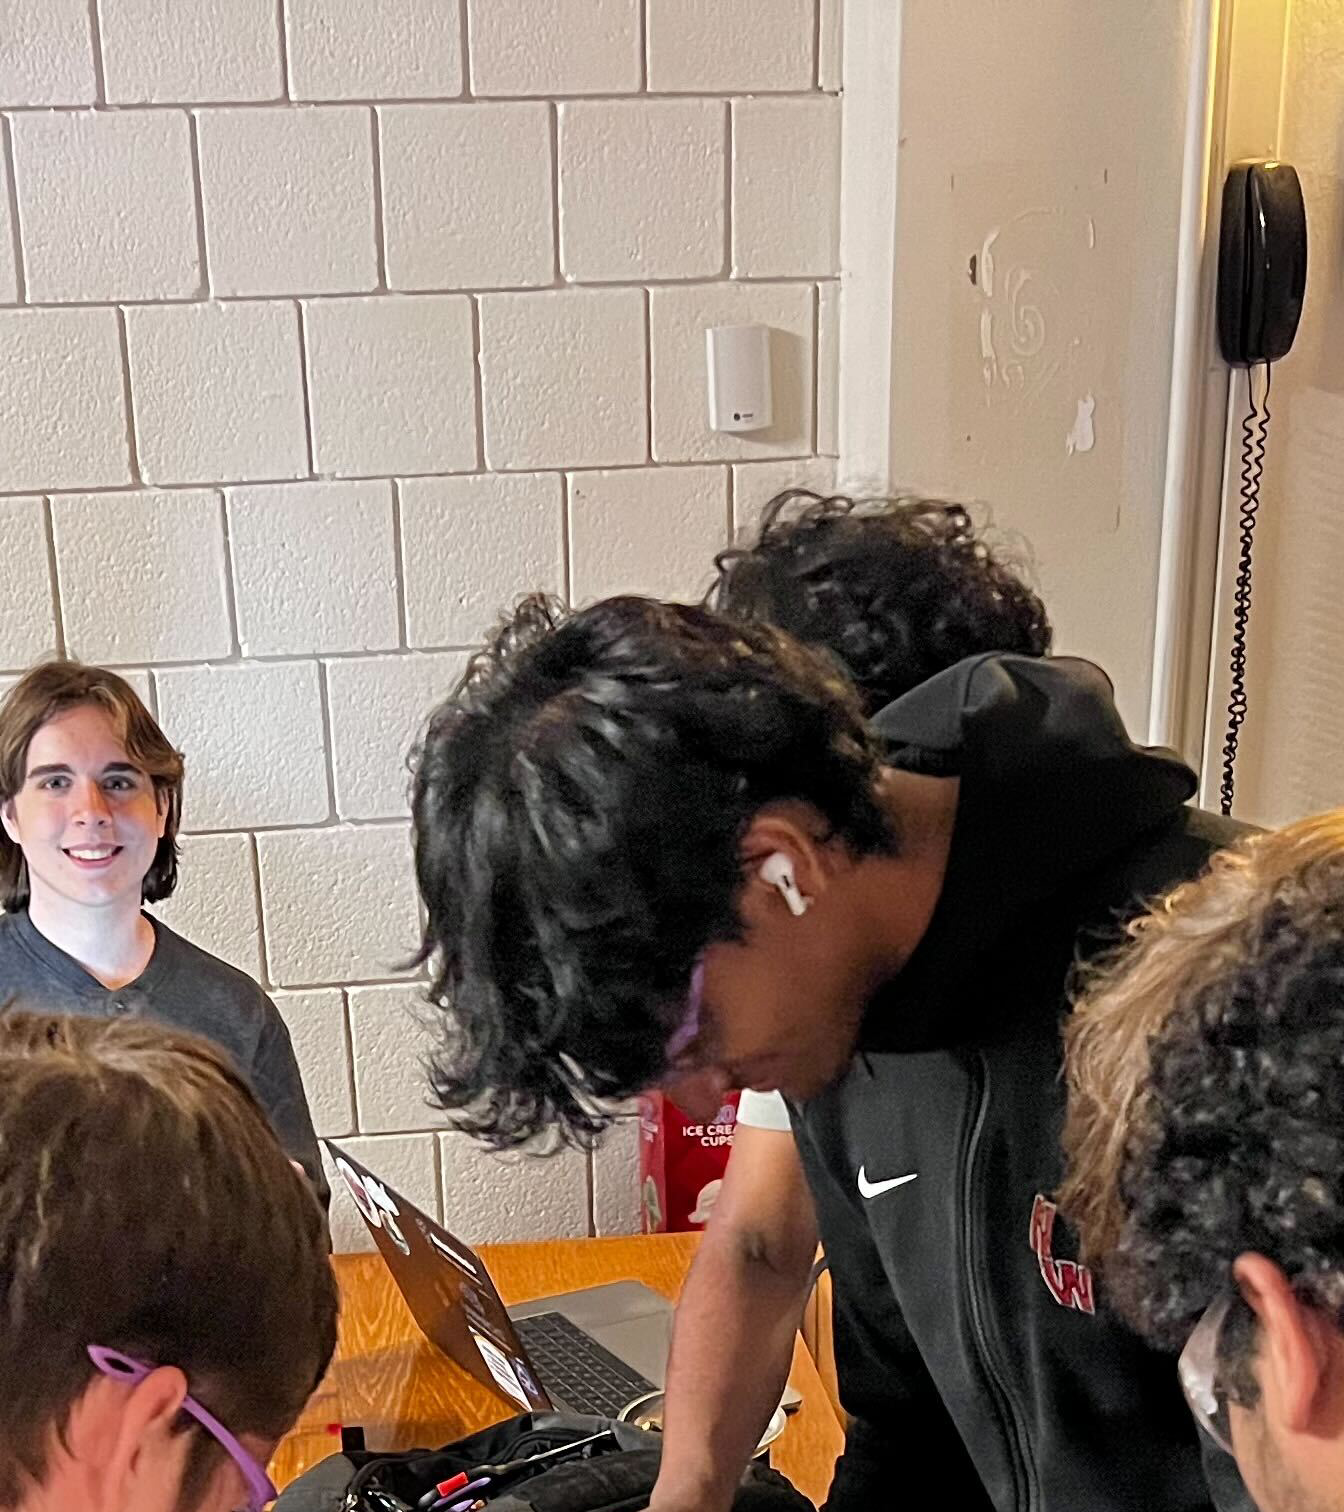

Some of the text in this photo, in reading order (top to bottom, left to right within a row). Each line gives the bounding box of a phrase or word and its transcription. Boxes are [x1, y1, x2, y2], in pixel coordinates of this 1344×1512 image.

[682, 1125, 737, 1137] ICE CRE
[701, 1136, 734, 1147] CUPS
